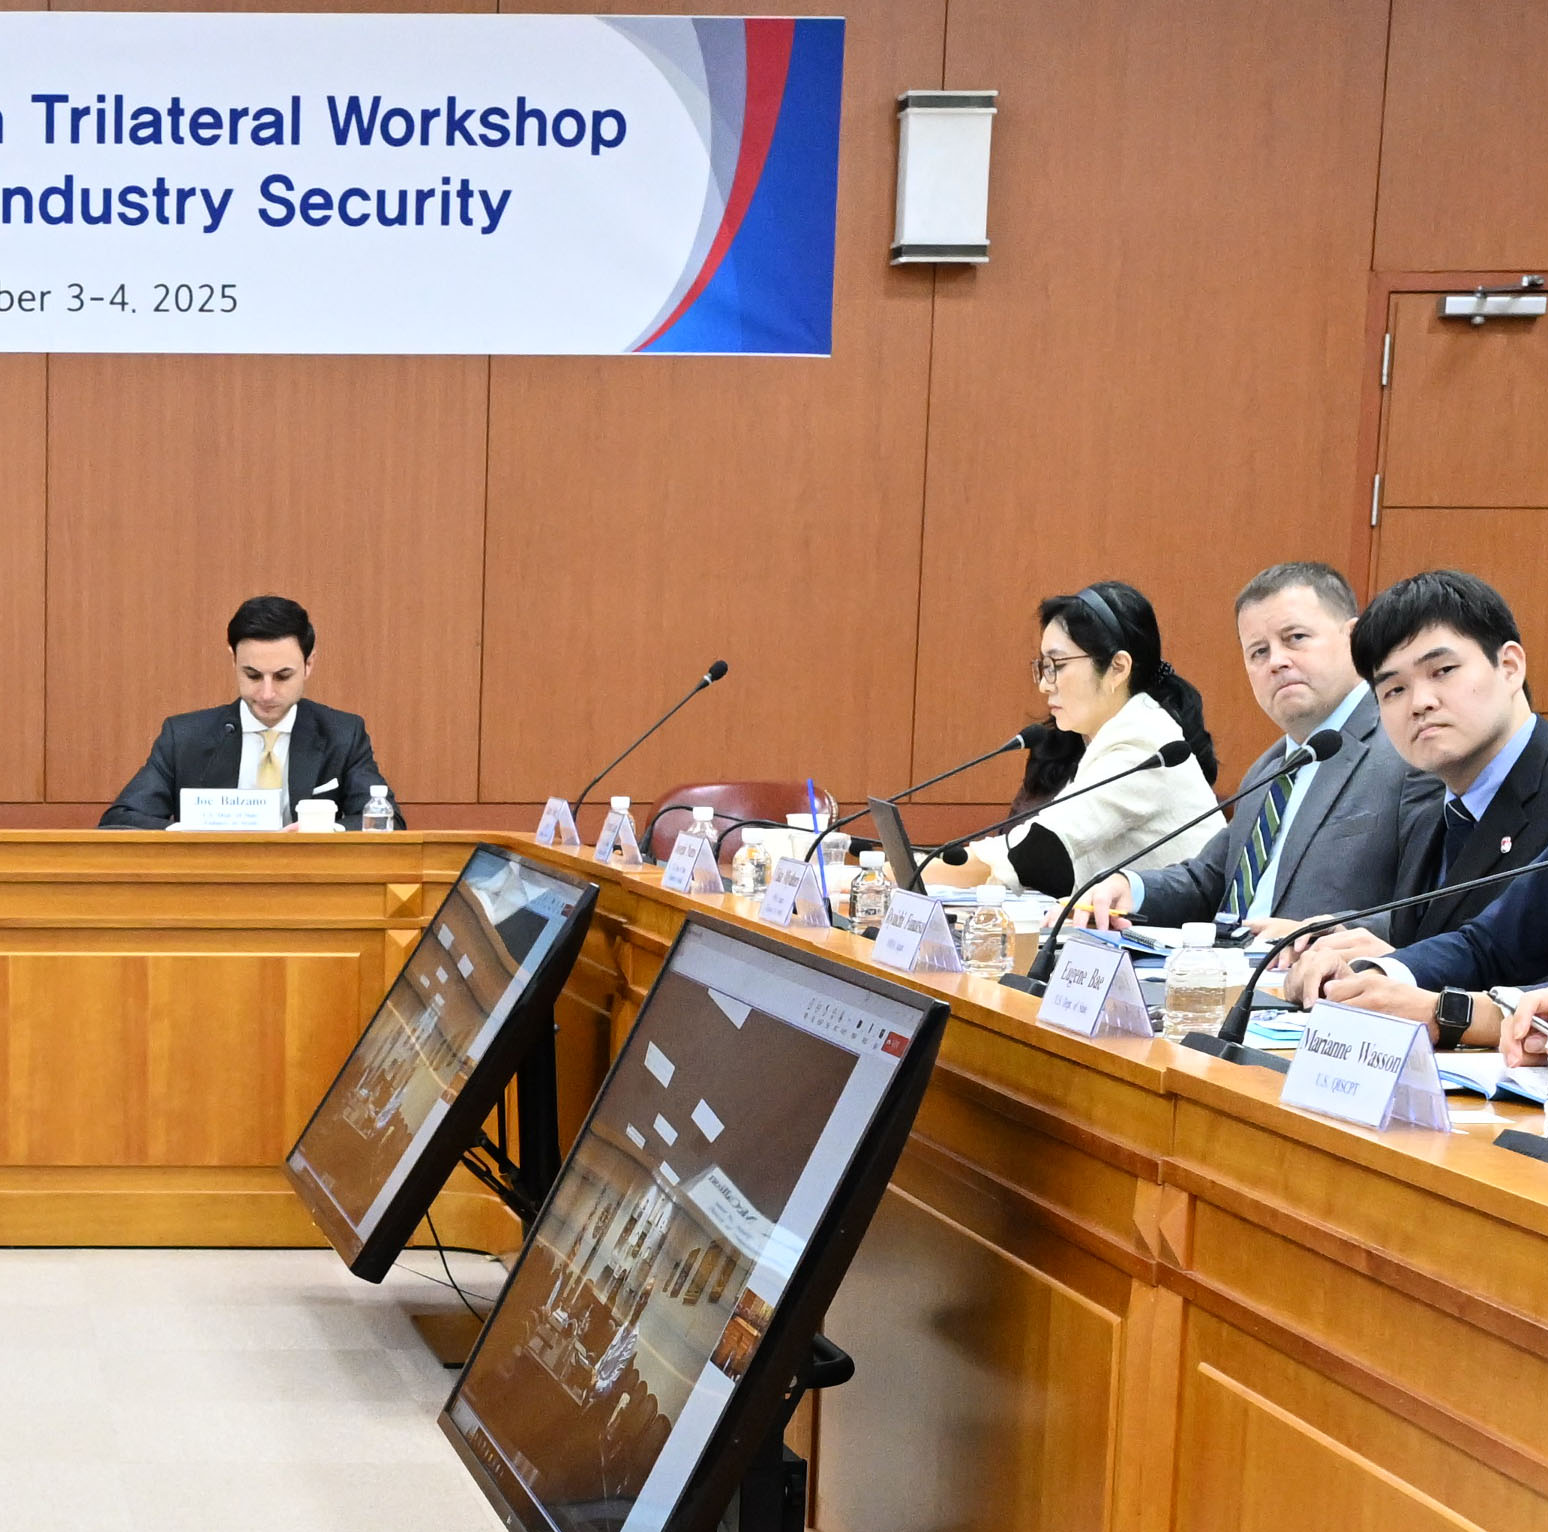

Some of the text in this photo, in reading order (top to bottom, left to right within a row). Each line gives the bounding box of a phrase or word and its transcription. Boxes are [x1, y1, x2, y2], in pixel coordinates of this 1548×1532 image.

[31, 93, 301, 146] Trilateral
[326, 95, 628, 156] Workshop
[257, 173, 512, 235] Security
[152, 284, 238, 313] 2025
[195, 796, 214, 806] Joe
[1061, 961, 1105, 990] Eugene Bae
[1303, 1027, 1403, 1074] Marianne Wasson
